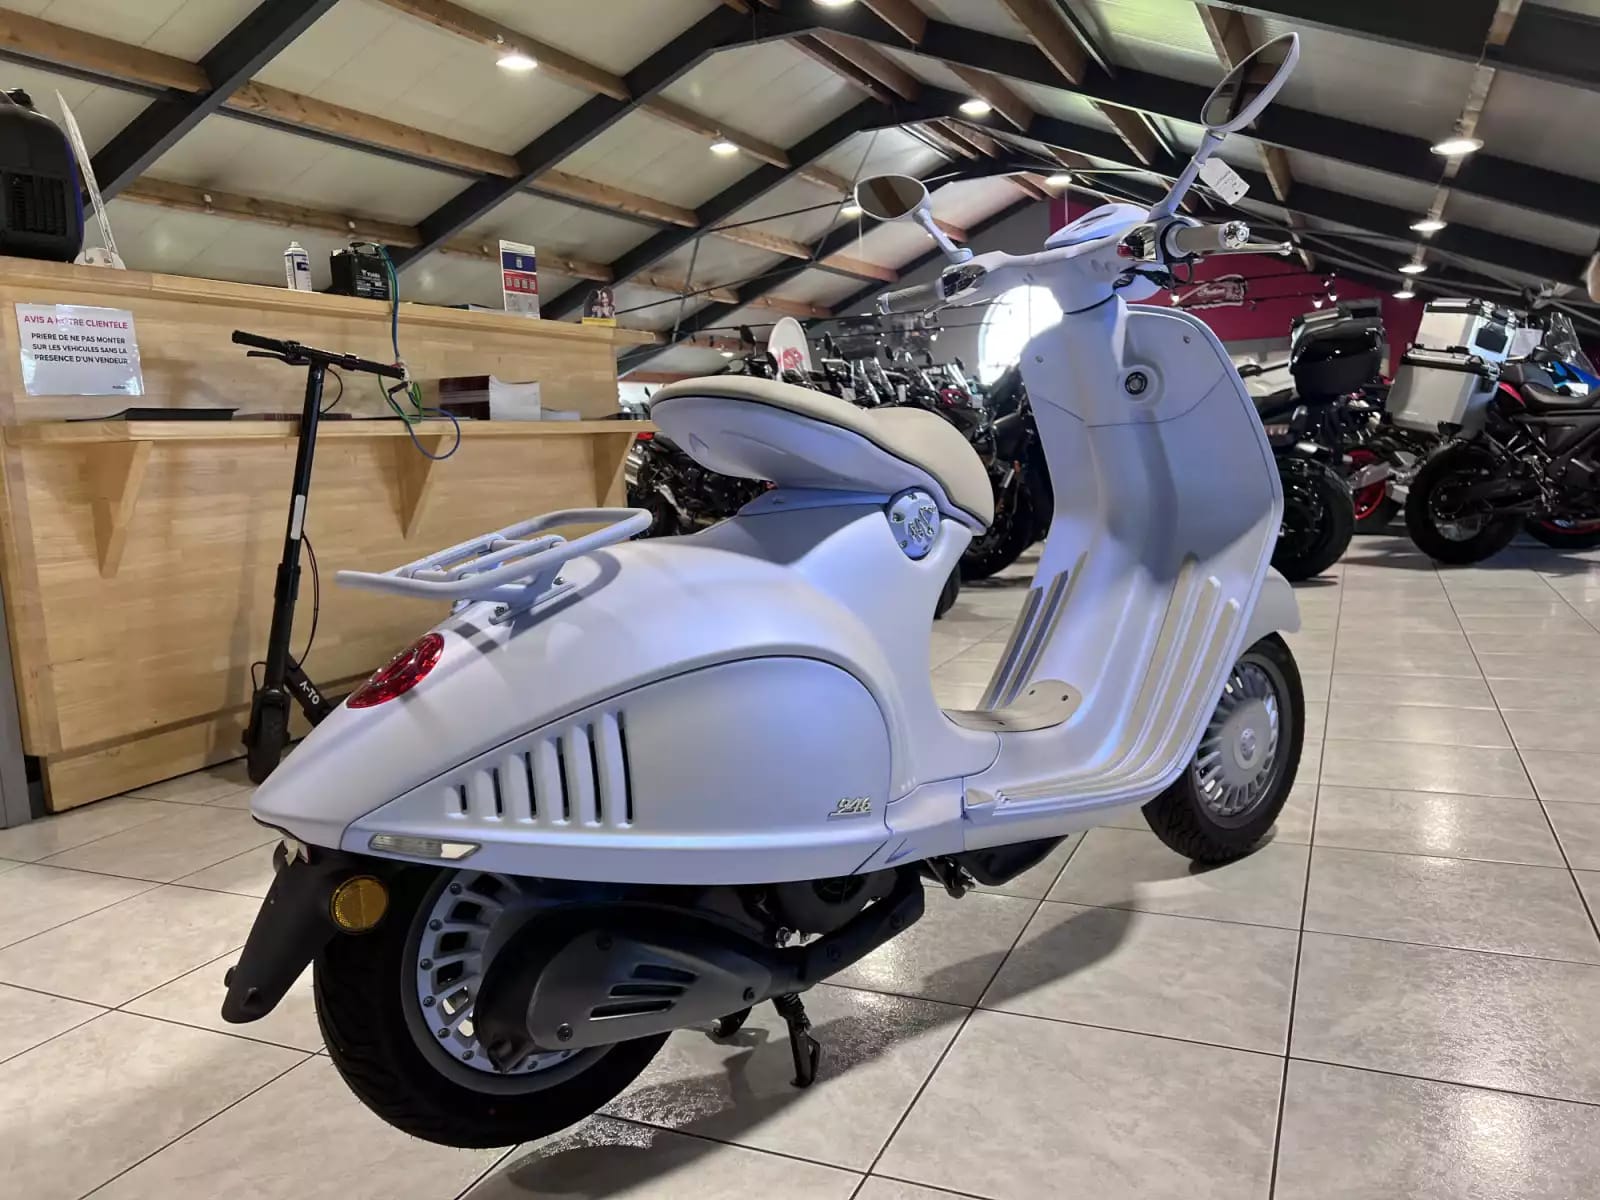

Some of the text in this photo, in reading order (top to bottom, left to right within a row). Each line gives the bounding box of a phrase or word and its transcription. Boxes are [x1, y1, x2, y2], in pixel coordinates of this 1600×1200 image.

[25, 315, 128, 329] AVIS A NTRE CLIENTELE
[31, 332, 57, 340] PRIERE
[81, 335, 95, 343] PAS
[96, 336, 126, 344] MONTER
[62, 345, 99, 353] VEHICULES
[34, 354, 128, 365] PRESENCE D'UN VENDEUR
